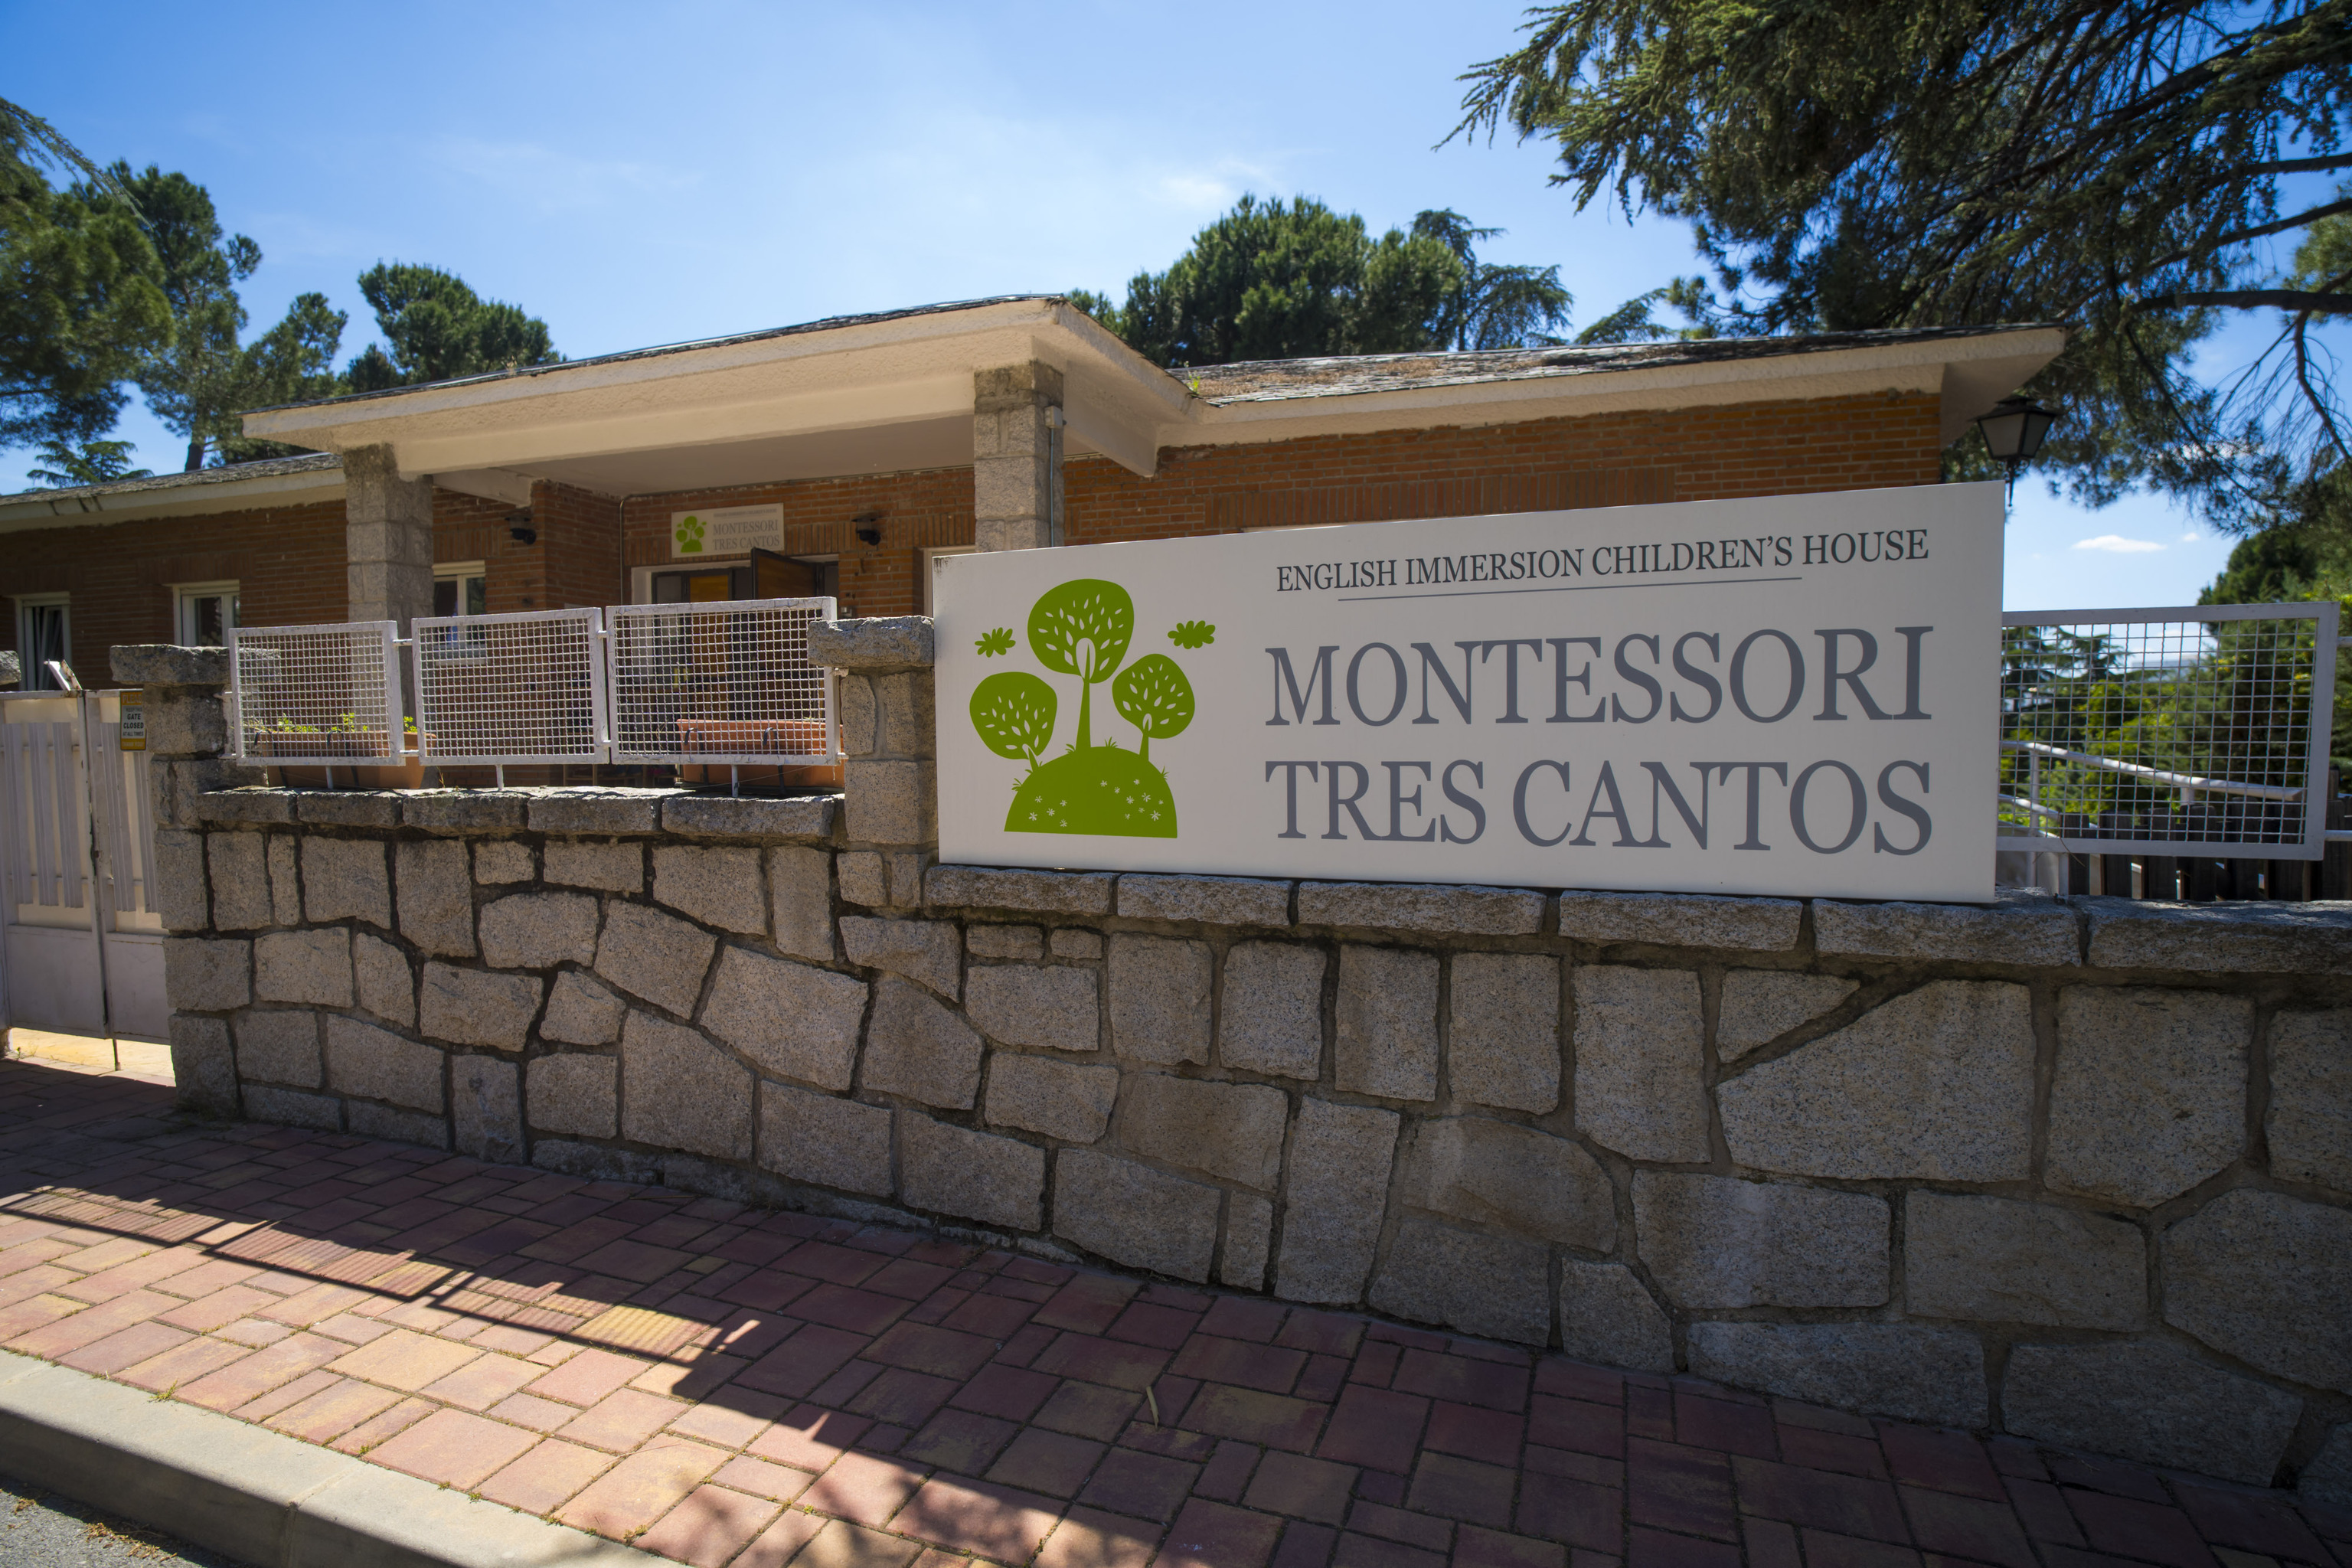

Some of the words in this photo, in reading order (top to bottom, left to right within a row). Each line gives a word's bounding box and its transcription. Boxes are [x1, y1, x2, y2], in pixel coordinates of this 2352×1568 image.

[712, 537, 738, 550] TRES
[740, 534, 780, 549] CANTOS
[713, 519, 779, 536] MONTESSORI
[1276, 558, 1397, 592] ENGLISH
[1404, 548, 1585, 586] IMMERSION
[1592, 535, 1793, 576] CHILDREN'S
[1802, 527, 1931, 566] HOUSE
[1265, 625, 1936, 727] MONTESSORI
[122, 694, 142, 704] PLEAS
[1265, 759, 1487, 845] TRES
[1512, 759, 1933, 857] CANTOS
